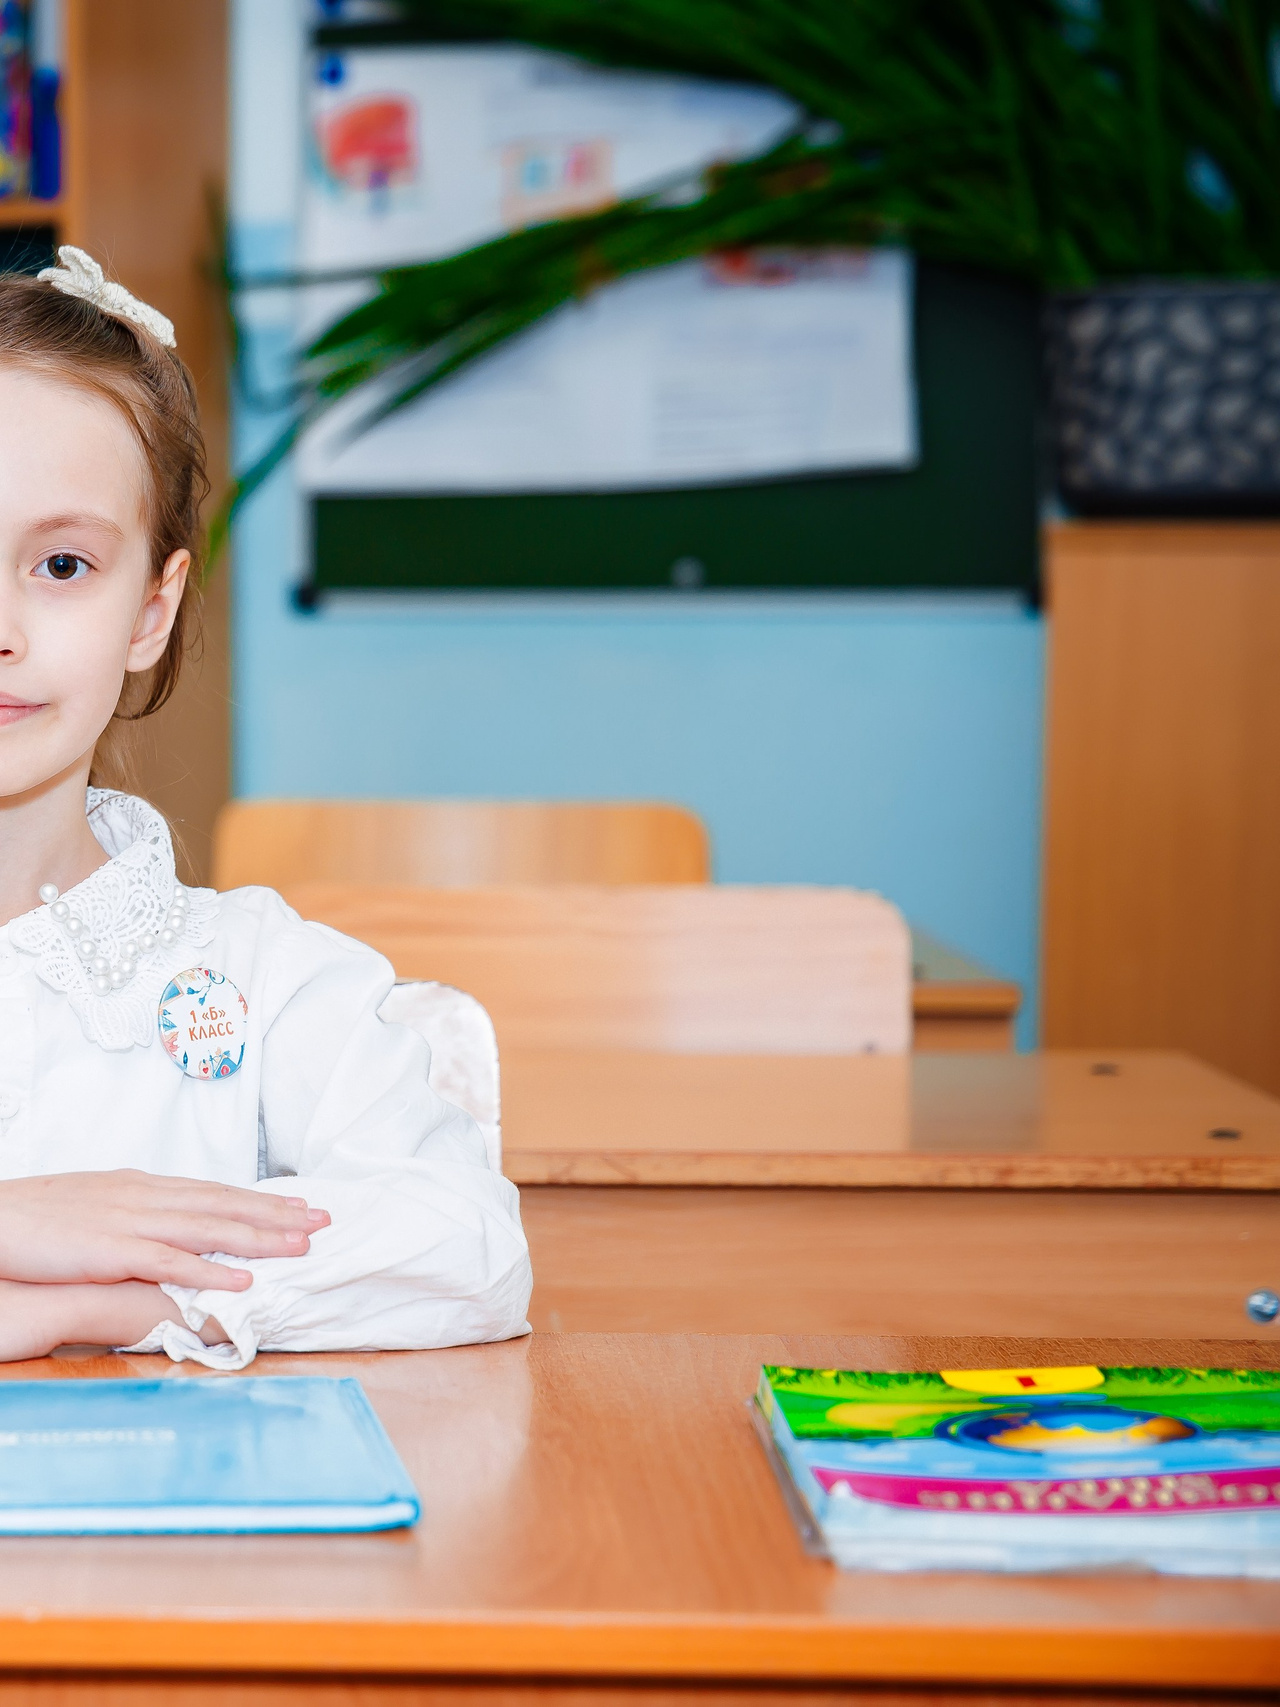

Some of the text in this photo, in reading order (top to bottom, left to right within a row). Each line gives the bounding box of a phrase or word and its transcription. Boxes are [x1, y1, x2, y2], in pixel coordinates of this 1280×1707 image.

[190, 1006, 226, 1023] 1 «Б»
[189, 1021, 234, 1041] КЛАСС
